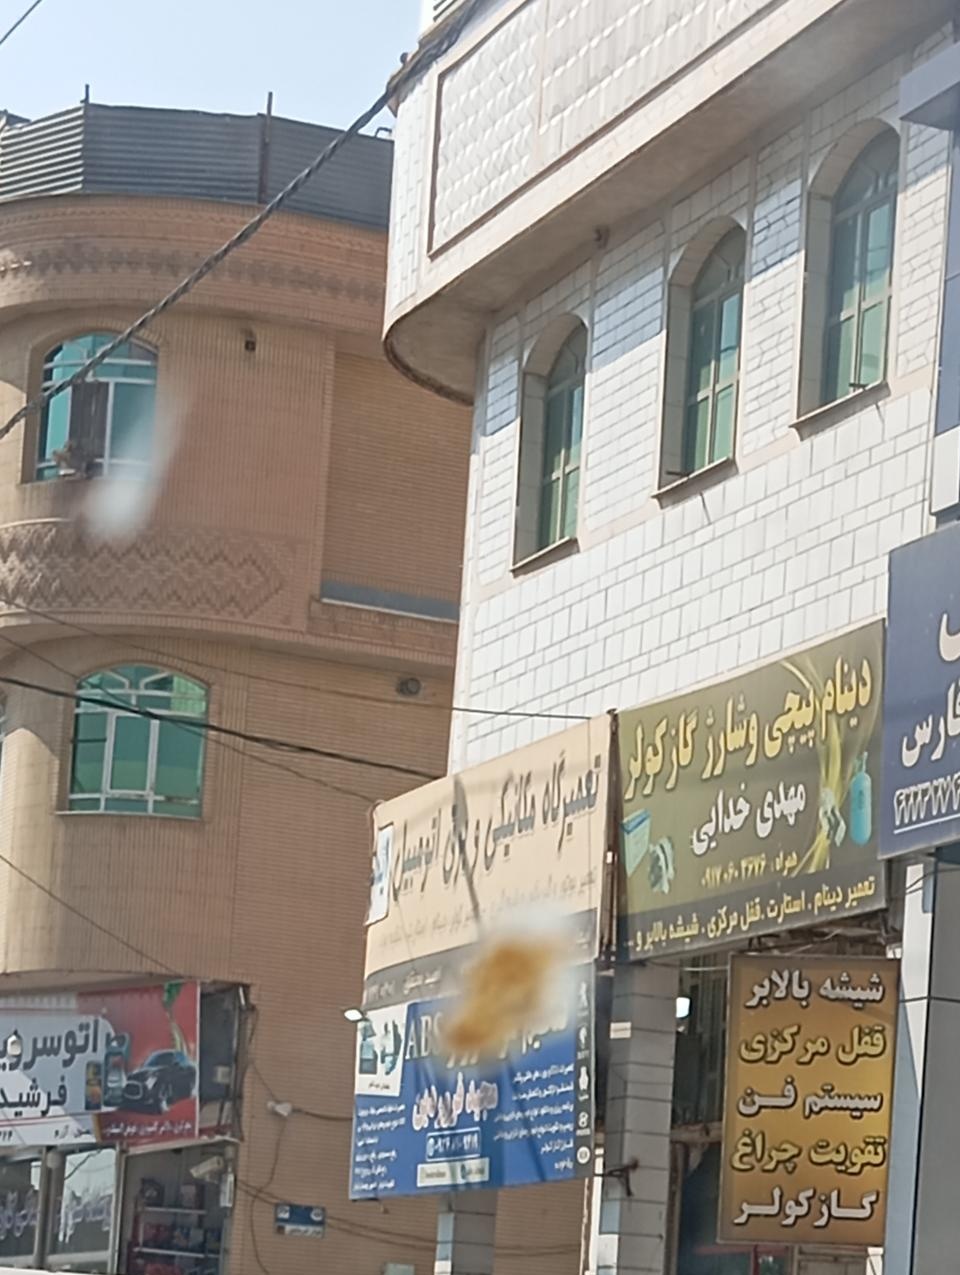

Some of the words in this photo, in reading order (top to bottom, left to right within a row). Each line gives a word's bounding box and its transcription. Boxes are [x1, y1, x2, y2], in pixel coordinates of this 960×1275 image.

[821, 656, 872, 740] دینام
[764, 685, 815, 758] پیچی
[484, 769, 536, 872] مکانیکی
[542, 750, 602, 854] تعمیرگاه
[692, 782, 751, 856] خدایی
[756, 781, 806, 838] مهدی
[392, 808, 442, 902] اتومبیل
[767, 890, 806, 924] استارت
[813, 883, 843, 915] دینام
[846, 876, 876, 908] تعمیر
[669, 912, 699, 943] شیشه
[706, 905, 738, 939] مرکزی
[740, 896, 761, 931] قفل
[745, 968, 811, 1009] بالابر
[819, 971, 884, 1009] شیشه
[740, 1023, 830, 1064] مرکزی
[837, 1024, 886, 1064] قفل
[738, 1076, 797, 1116] فن
[804, 1083, 882, 1119] سیستم
[731, 1128, 800, 1173] چراغ
[809, 1135, 887, 1175] تقویت
